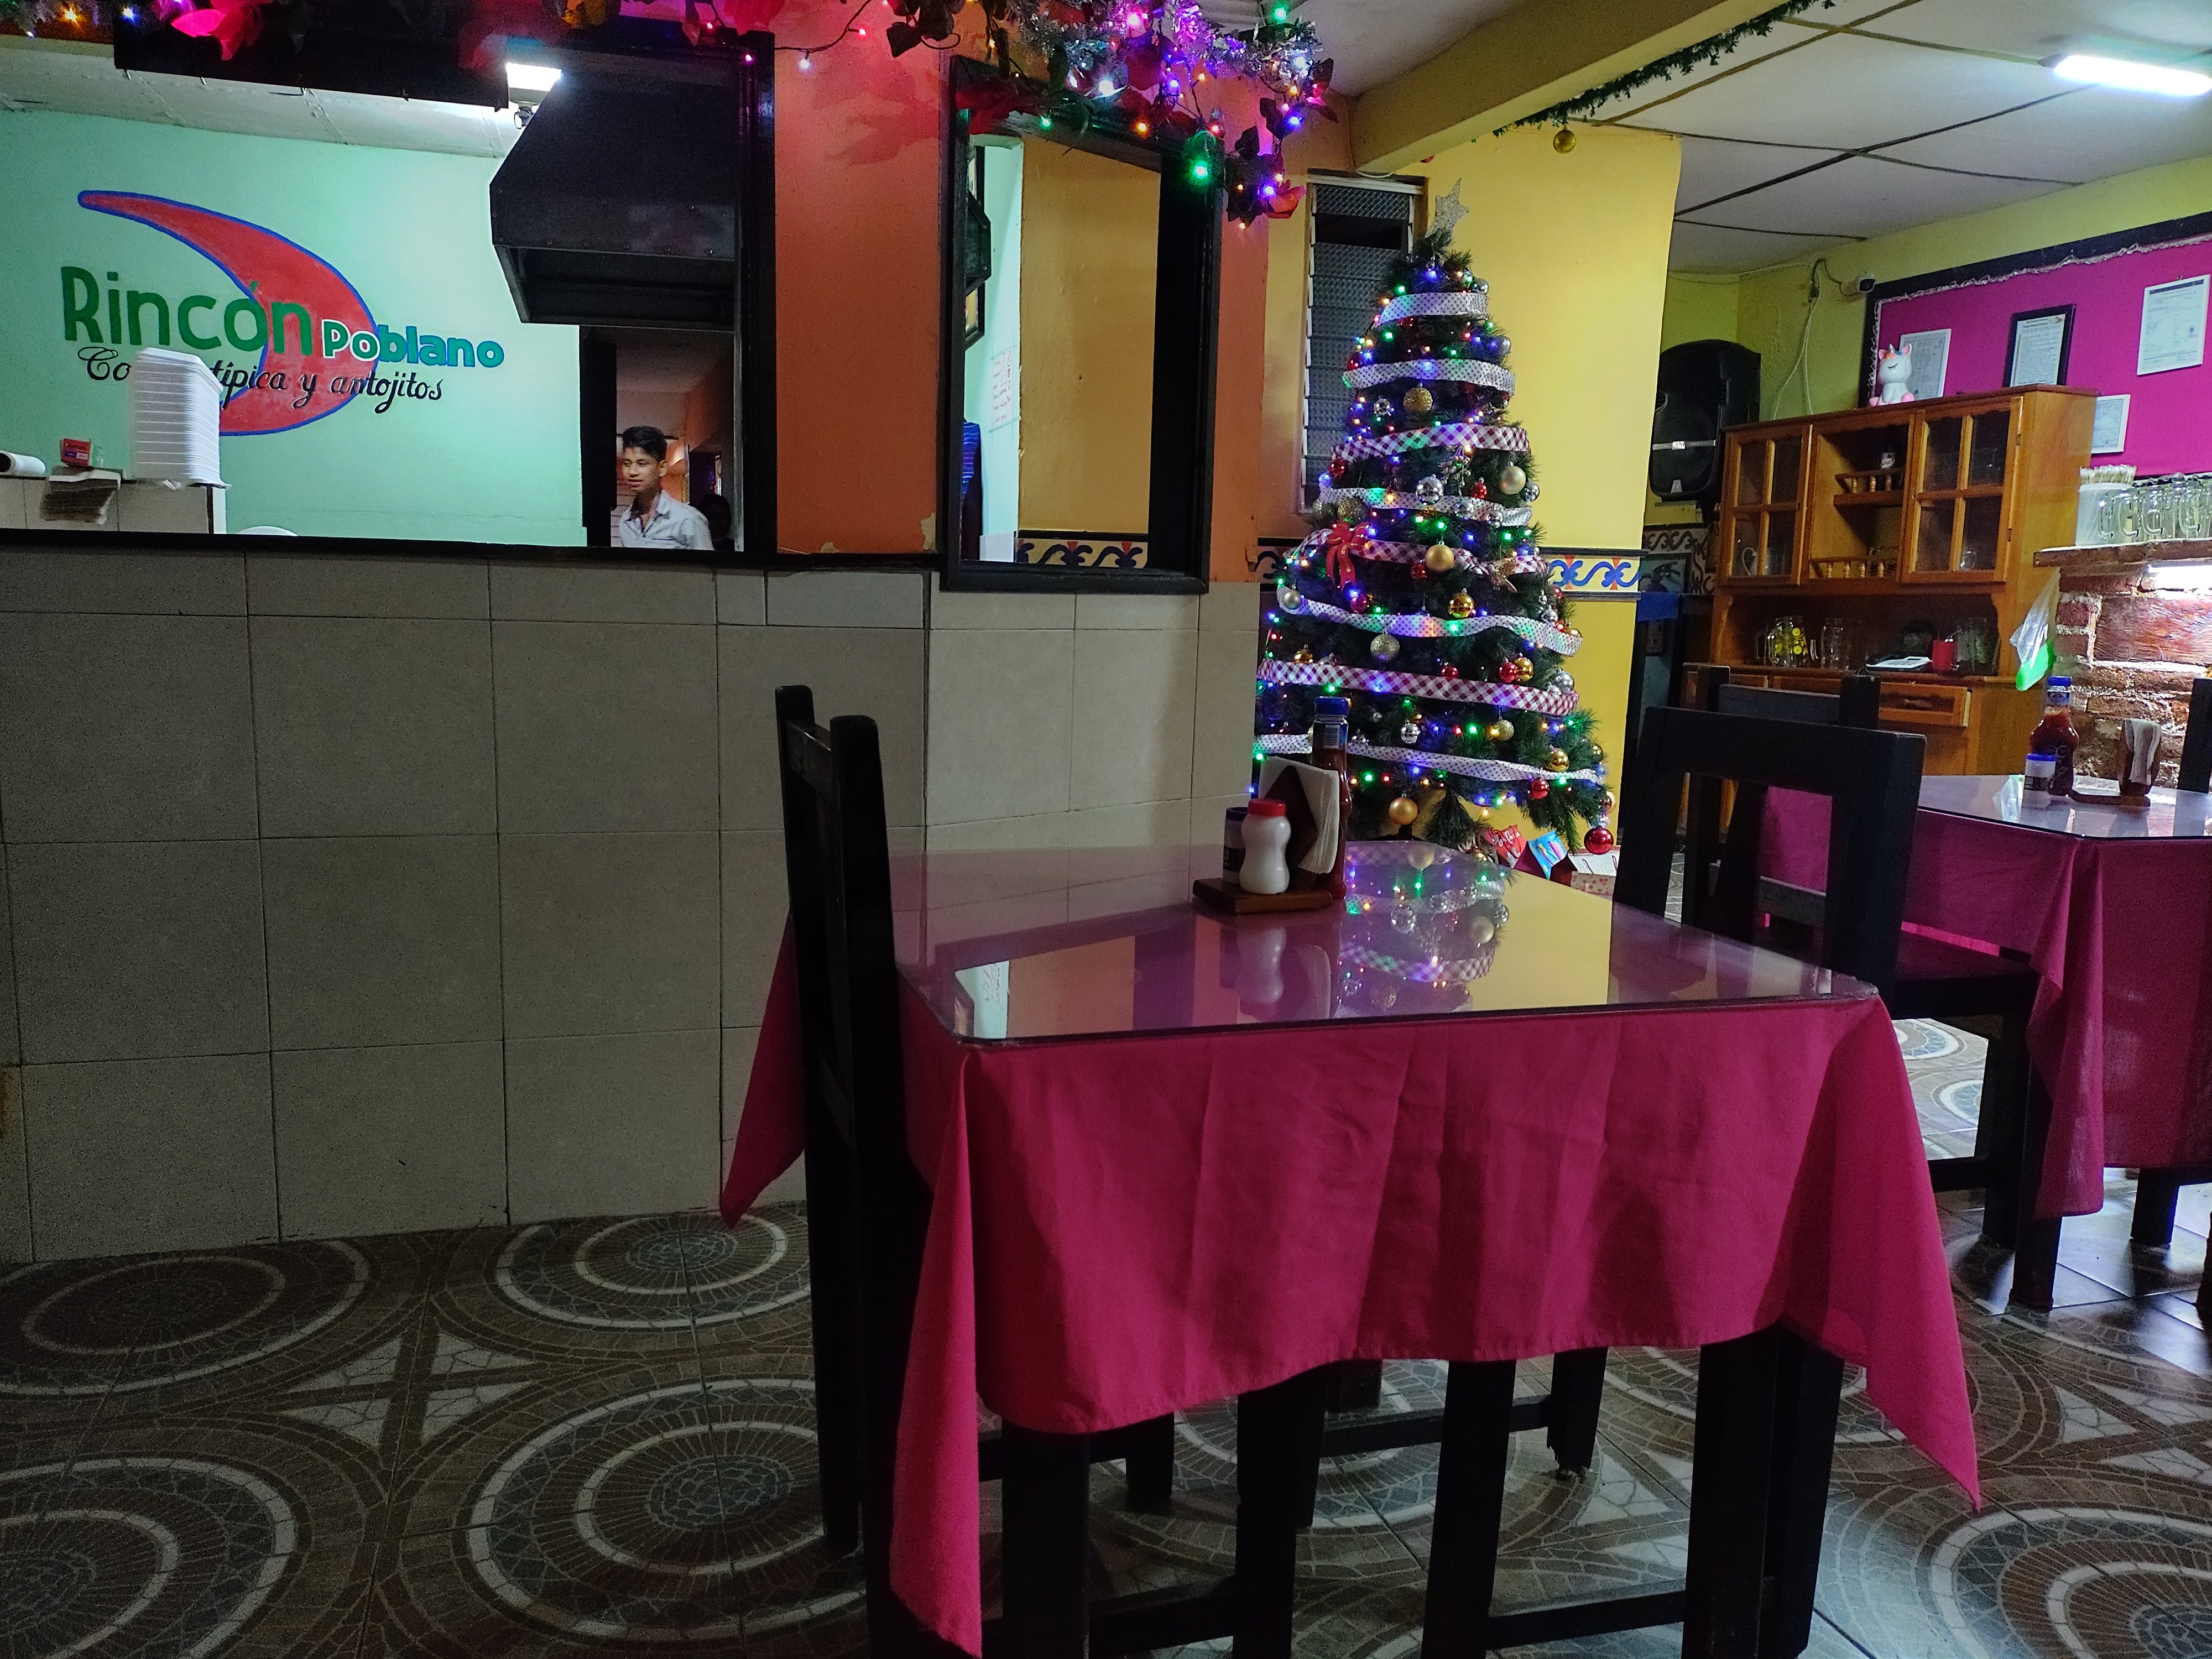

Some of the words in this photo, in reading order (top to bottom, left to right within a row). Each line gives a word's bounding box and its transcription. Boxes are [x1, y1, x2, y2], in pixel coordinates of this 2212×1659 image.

[61, 266, 313, 356] Rincón
[321, 319, 504, 368] Poblano
[293, 372, 318, 409] y
[330, 370, 443, 414] antojitos
